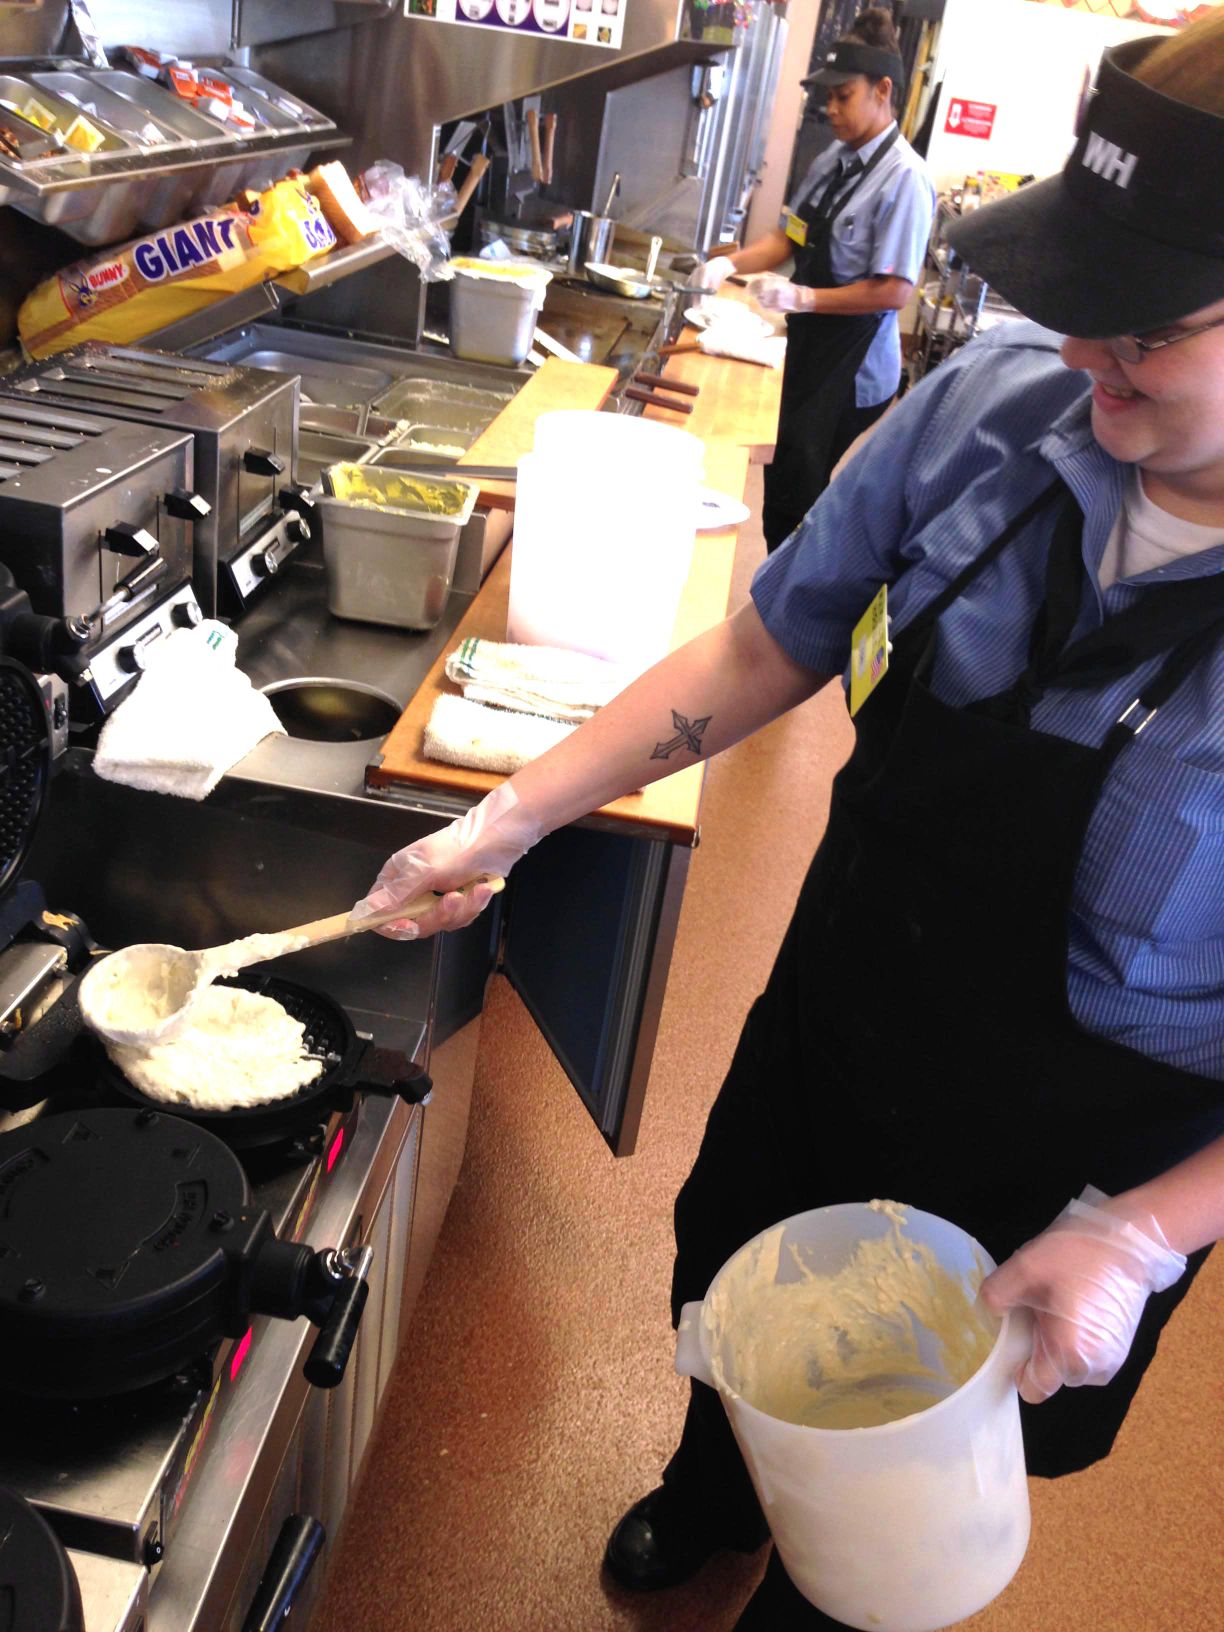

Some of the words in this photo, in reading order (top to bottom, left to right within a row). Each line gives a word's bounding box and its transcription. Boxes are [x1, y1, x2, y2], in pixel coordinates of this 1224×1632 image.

[1081, 130, 1138, 189] WH
[88, 262, 125, 288] BUNNY
[135, 217, 236, 279] GIANT
